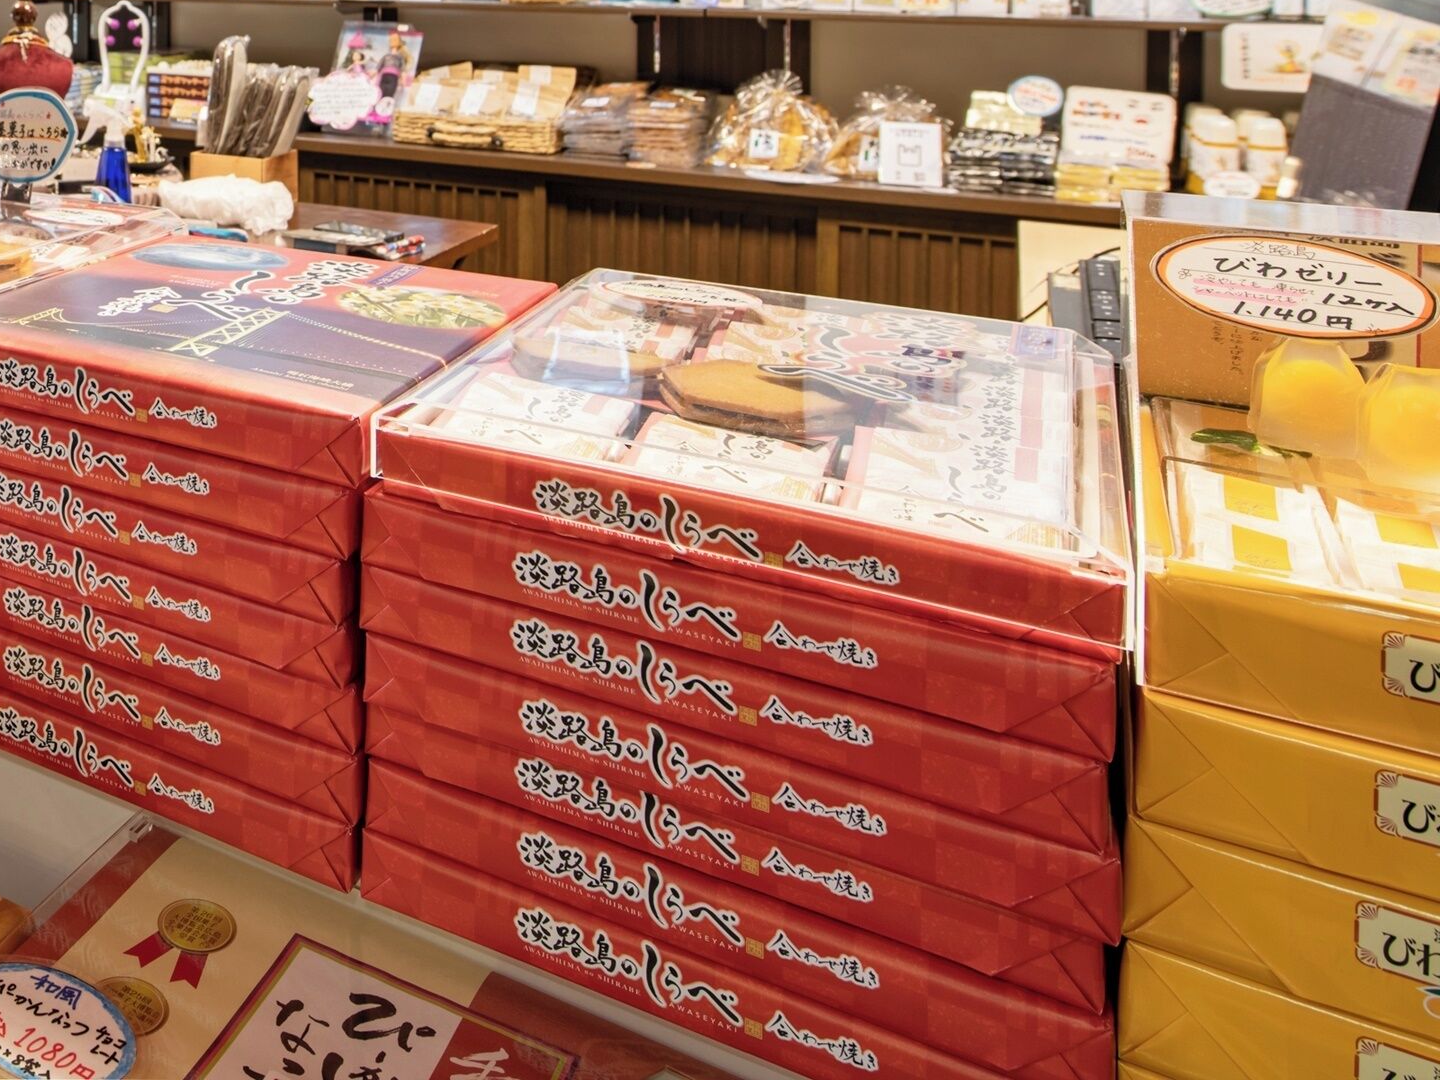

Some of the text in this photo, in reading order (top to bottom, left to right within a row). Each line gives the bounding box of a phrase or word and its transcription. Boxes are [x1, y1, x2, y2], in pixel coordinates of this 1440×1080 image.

[1213, 256, 1383, 287] びわゼリー
[151, 399, 216, 427] 合わせ焼き
[143, 464, 209, 494] 合わせ焼き
[132, 522, 197, 554] 合わせ焼き
[536, 481, 898, 583] 淡路島のしらべ 合わせ焼き
[146, 588, 210, 621] 合わせ焼き
[515, 553, 875, 666] 淡路島のしらべ 合わせ焼き
[522, 588, 577, 608] AWAJISHIMA
[596, 607, 639, 624] SHIRABE
[4, 589, 220, 680] 淡路島のしらべ 合わせ焼き
[665, 626, 737, 648] AWASEYAKI
[513, 621, 871, 744] 淡路島のしらべ 合わせ焼き
[519, 656, 574, 677] AWAJISHIMA
[593, 678, 636, 696] SHIRABE
[4, 648, 220, 745] 淡路島のしらべ 合わせ焼き
[664, 698, 733, 722] AWASEYAKI
[522, 701, 885, 834] 淡路島のしらべ 合わせ焼き
[528, 737, 584, 759] AWAJISHIMA
[603, 761, 647, 779] SHIRABE
[149, 776, 214, 813] 合わせ焼き
[674, 783, 745, 808] AWASEYAKI
[517, 761, 871, 900] 淡路島のしらべ 合わせ焼き
[523, 794, 579, 816] AWAJISHIMA
[596, 818, 640, 838] SHIRABE
[666, 842, 736, 870] AWASEYAKI
[520, 834, 878, 987] 淡路島のしらべ 合わせ焼き
[526, 869, 583, 893] AWAJISHIMA
[599, 896, 644, 919] SHIRABE
[670, 923, 740, 953] AWASEYAKI
[523, 944, 581, 971] AWAJISHIMA
[597, 973, 641, 996] SHIRABE
[30, 975, 83, 1010] 和風
[517, 910, 876, 1069] 淡路島のしらべ 合わせ焼き
[668, 1001, 739, 1033] AWASEYAKI
[90, 1043, 120, 1066] レート
[96, 1026, 127, 1049] チョコ
